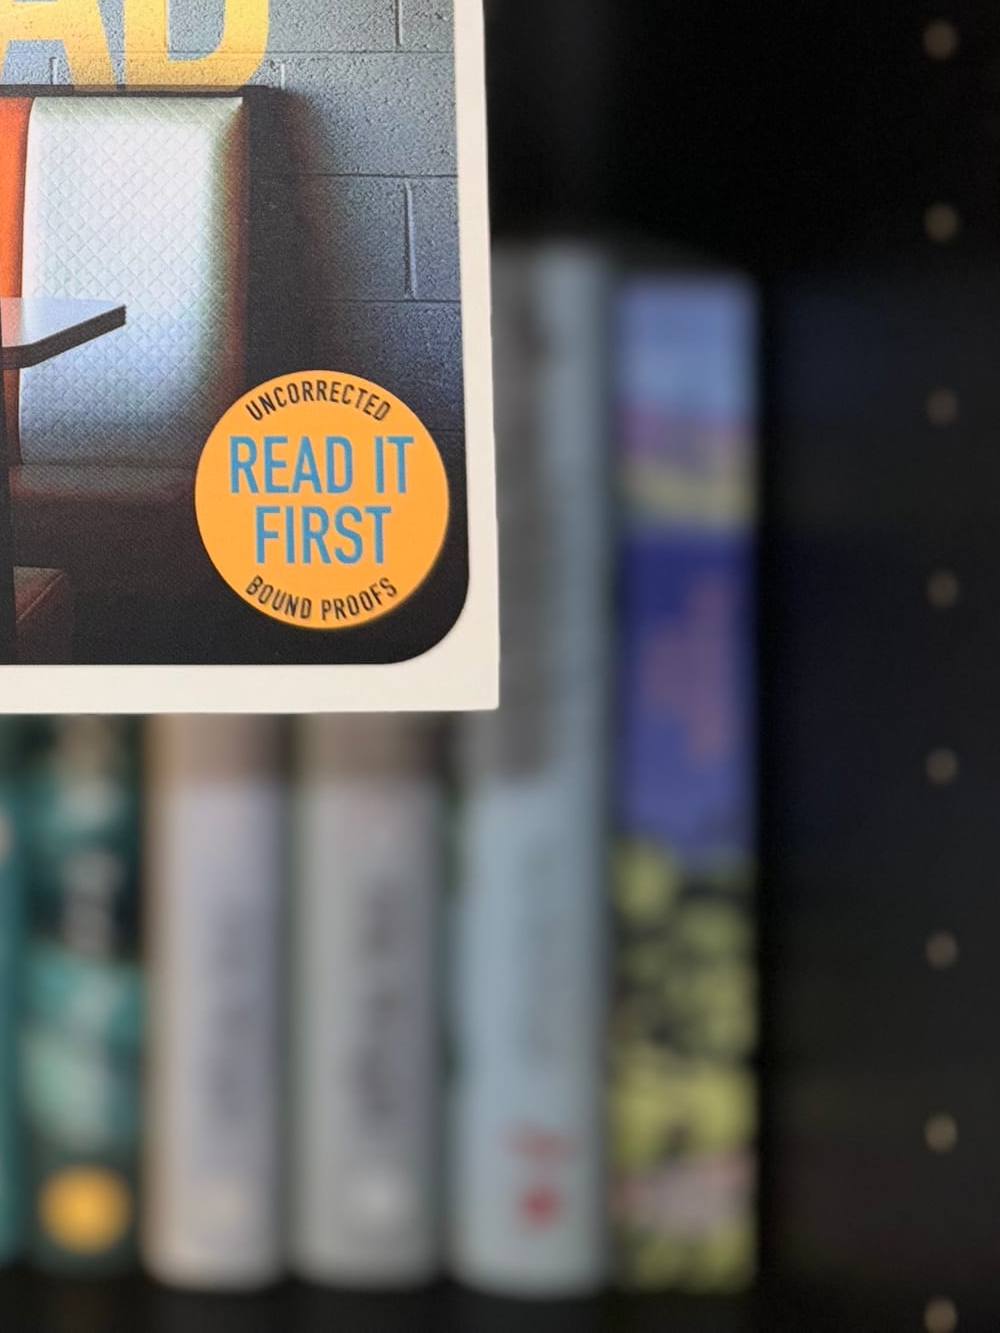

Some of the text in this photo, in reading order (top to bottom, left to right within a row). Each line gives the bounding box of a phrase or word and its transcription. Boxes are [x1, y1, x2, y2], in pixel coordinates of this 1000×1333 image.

[245, 379, 392, 421] UNCORRECTED
[229, 435, 415, 495] READ IT
[255, 505, 393, 565] FIRST
[245, 574, 398, 621] BOUND PROOFS
